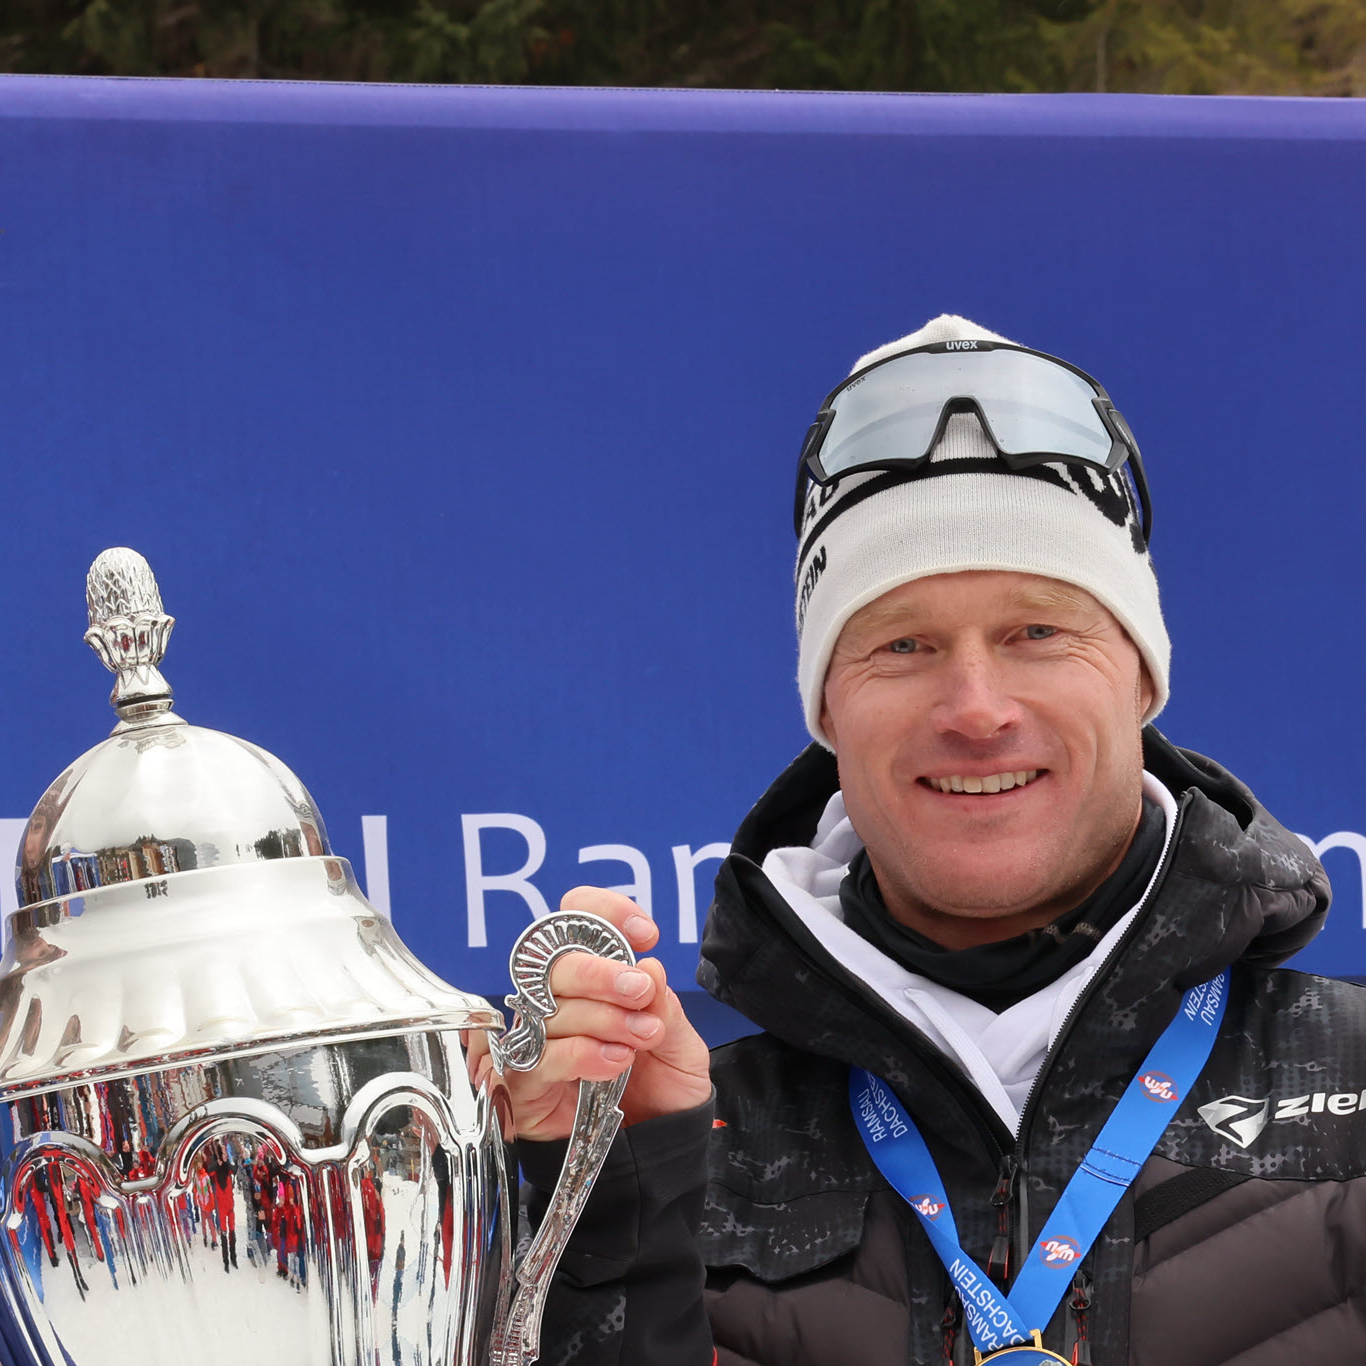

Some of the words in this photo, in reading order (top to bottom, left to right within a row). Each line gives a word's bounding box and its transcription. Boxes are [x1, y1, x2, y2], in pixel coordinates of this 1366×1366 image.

[946, 340, 978, 350] uvex
[846, 376, 867, 391] uvex
[858, 1088, 887, 1142] RAMSAU
